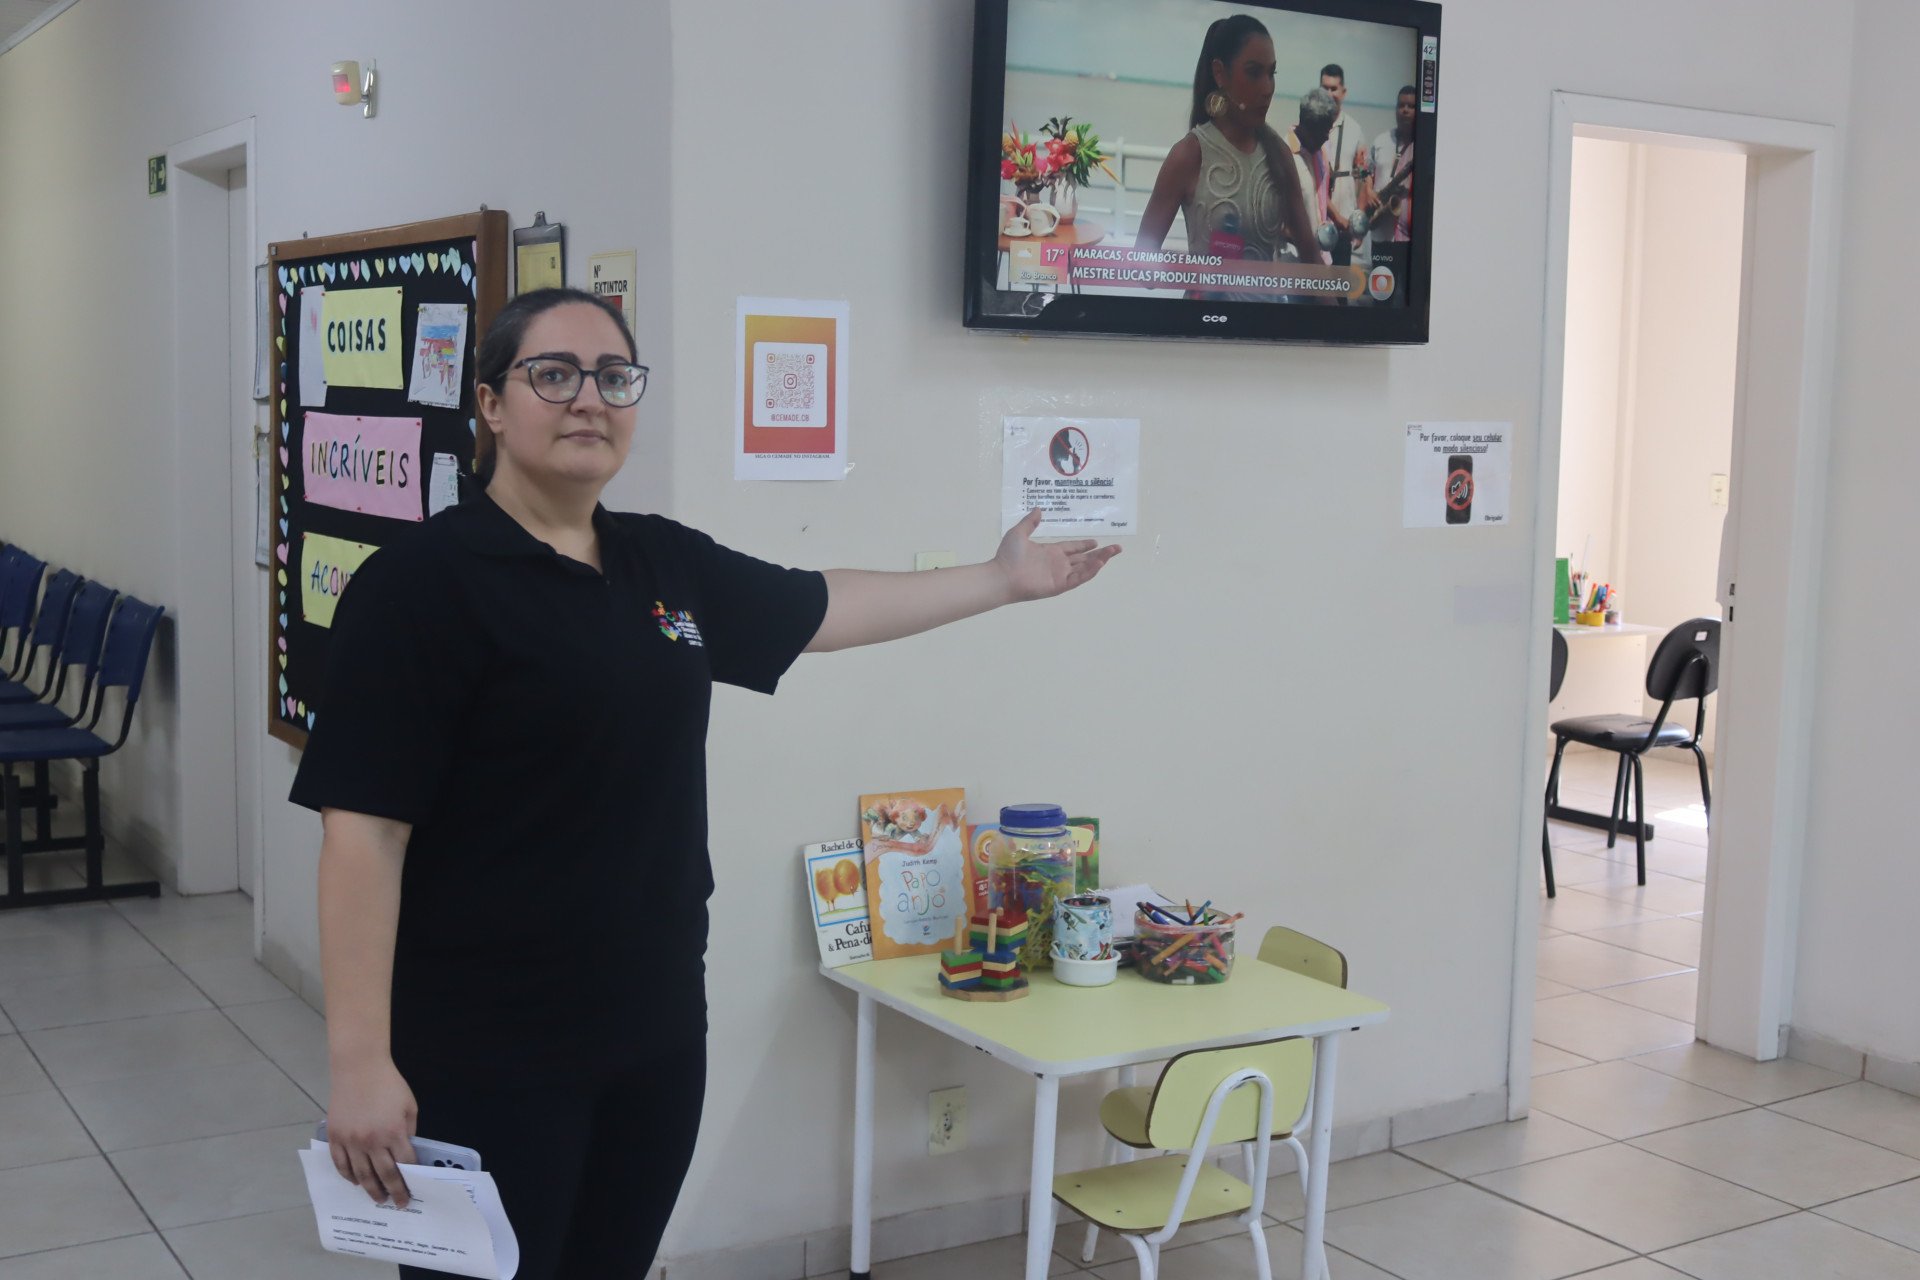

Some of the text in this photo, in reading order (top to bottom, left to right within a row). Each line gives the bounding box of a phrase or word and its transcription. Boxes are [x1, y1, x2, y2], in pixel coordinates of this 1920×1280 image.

[1046, 249, 1065, 262] 17°
[1073, 248, 1222, 266] MARACAS, CURIMBÓS E BANJOS
[1020, 271, 1057, 281] Rio Branco
[1073, 267, 1350, 292] MESTRE LUCAS PRODUZ INSTRUMENTOS DE PERCUSSÃO
[594, 279, 628, 294] EXTINTOR
[327, 317, 387, 353] COISAS
[1420, 433, 1429, 442] Por
[1450, 433, 1471, 443] coloque
[1473, 435, 1482, 443] seu
[1483, 433, 1502, 443] celular
[1442, 444, 1458, 454] modo
[311, 434, 409, 489] INCRÍVEIS
[1023, 477, 1033, 486] Por
[1054, 478, 1083, 486] mantenha
[311, 560, 356, 597] ACON
[821, 840, 846, 853] Rachel
[846, 840, 854, 849] de
[828, 944, 834, 952] &
